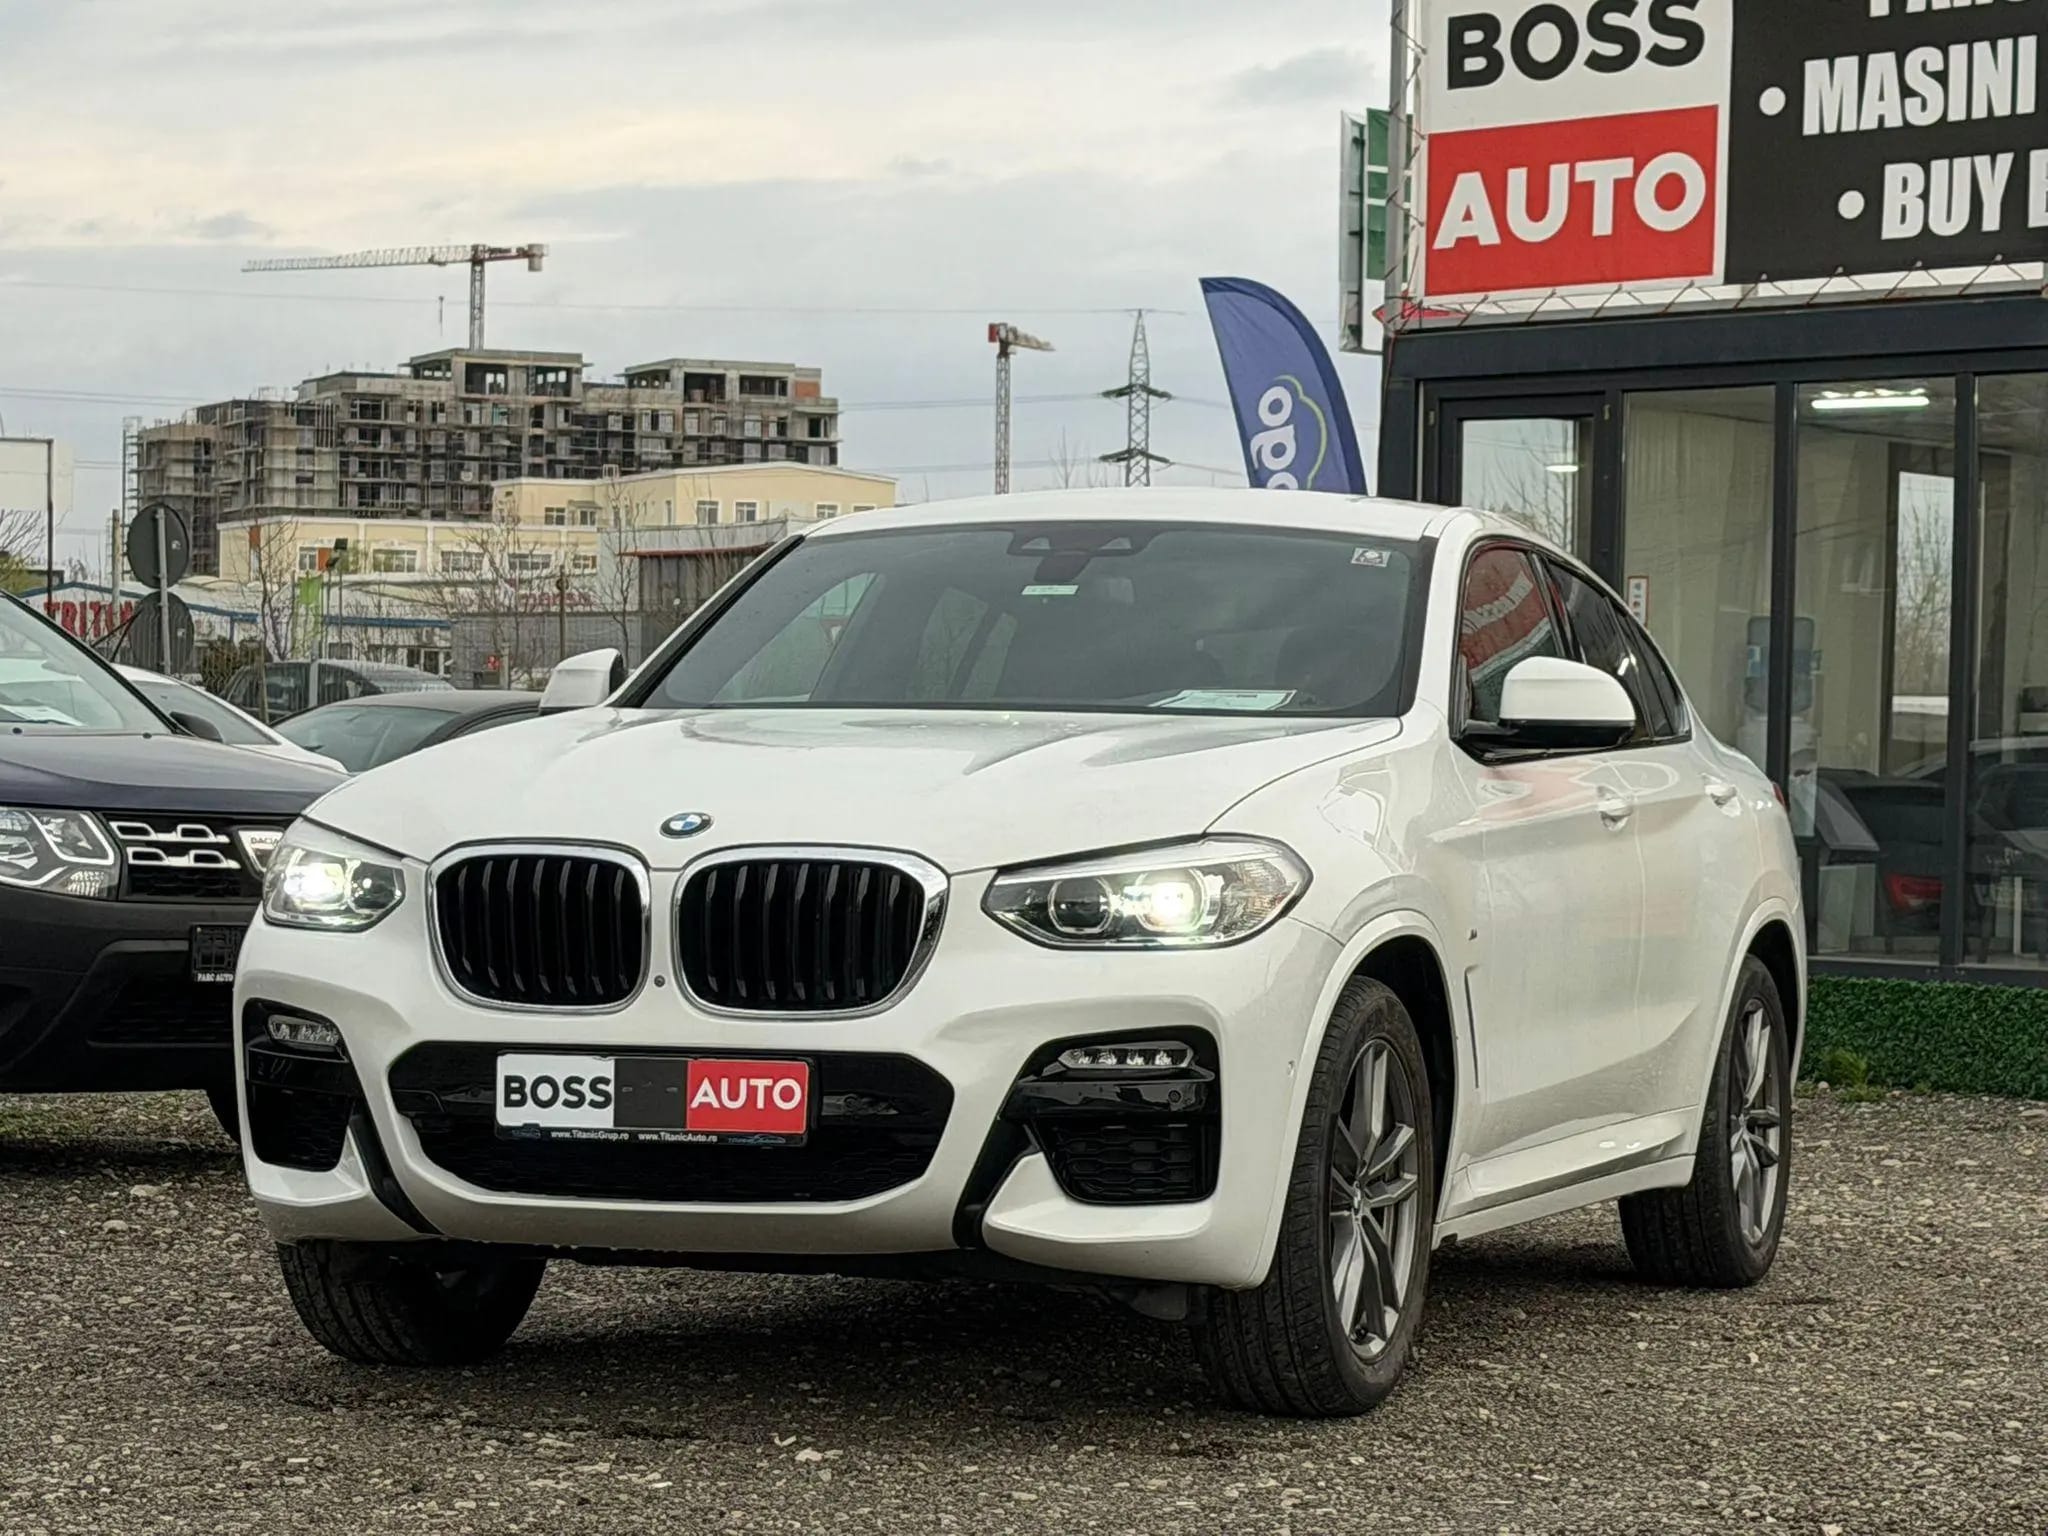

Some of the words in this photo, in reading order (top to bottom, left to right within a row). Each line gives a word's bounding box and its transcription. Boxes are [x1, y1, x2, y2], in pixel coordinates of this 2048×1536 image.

[1447, 0, 1705, 90] BOSS
[1802, 35, 2039, 136] MASINI
[1433, 152, 1706, 250] AUTO
[1881, 152, 2015, 241] BUY
[503, 1075, 612, 1109] BOSS
[690, 1077, 802, 1110] AUTO
[550, 1130, 630, 1141] www.TitanicGrup.ro
[637, 1131, 718, 1143] www.TitanicAuto.ro
